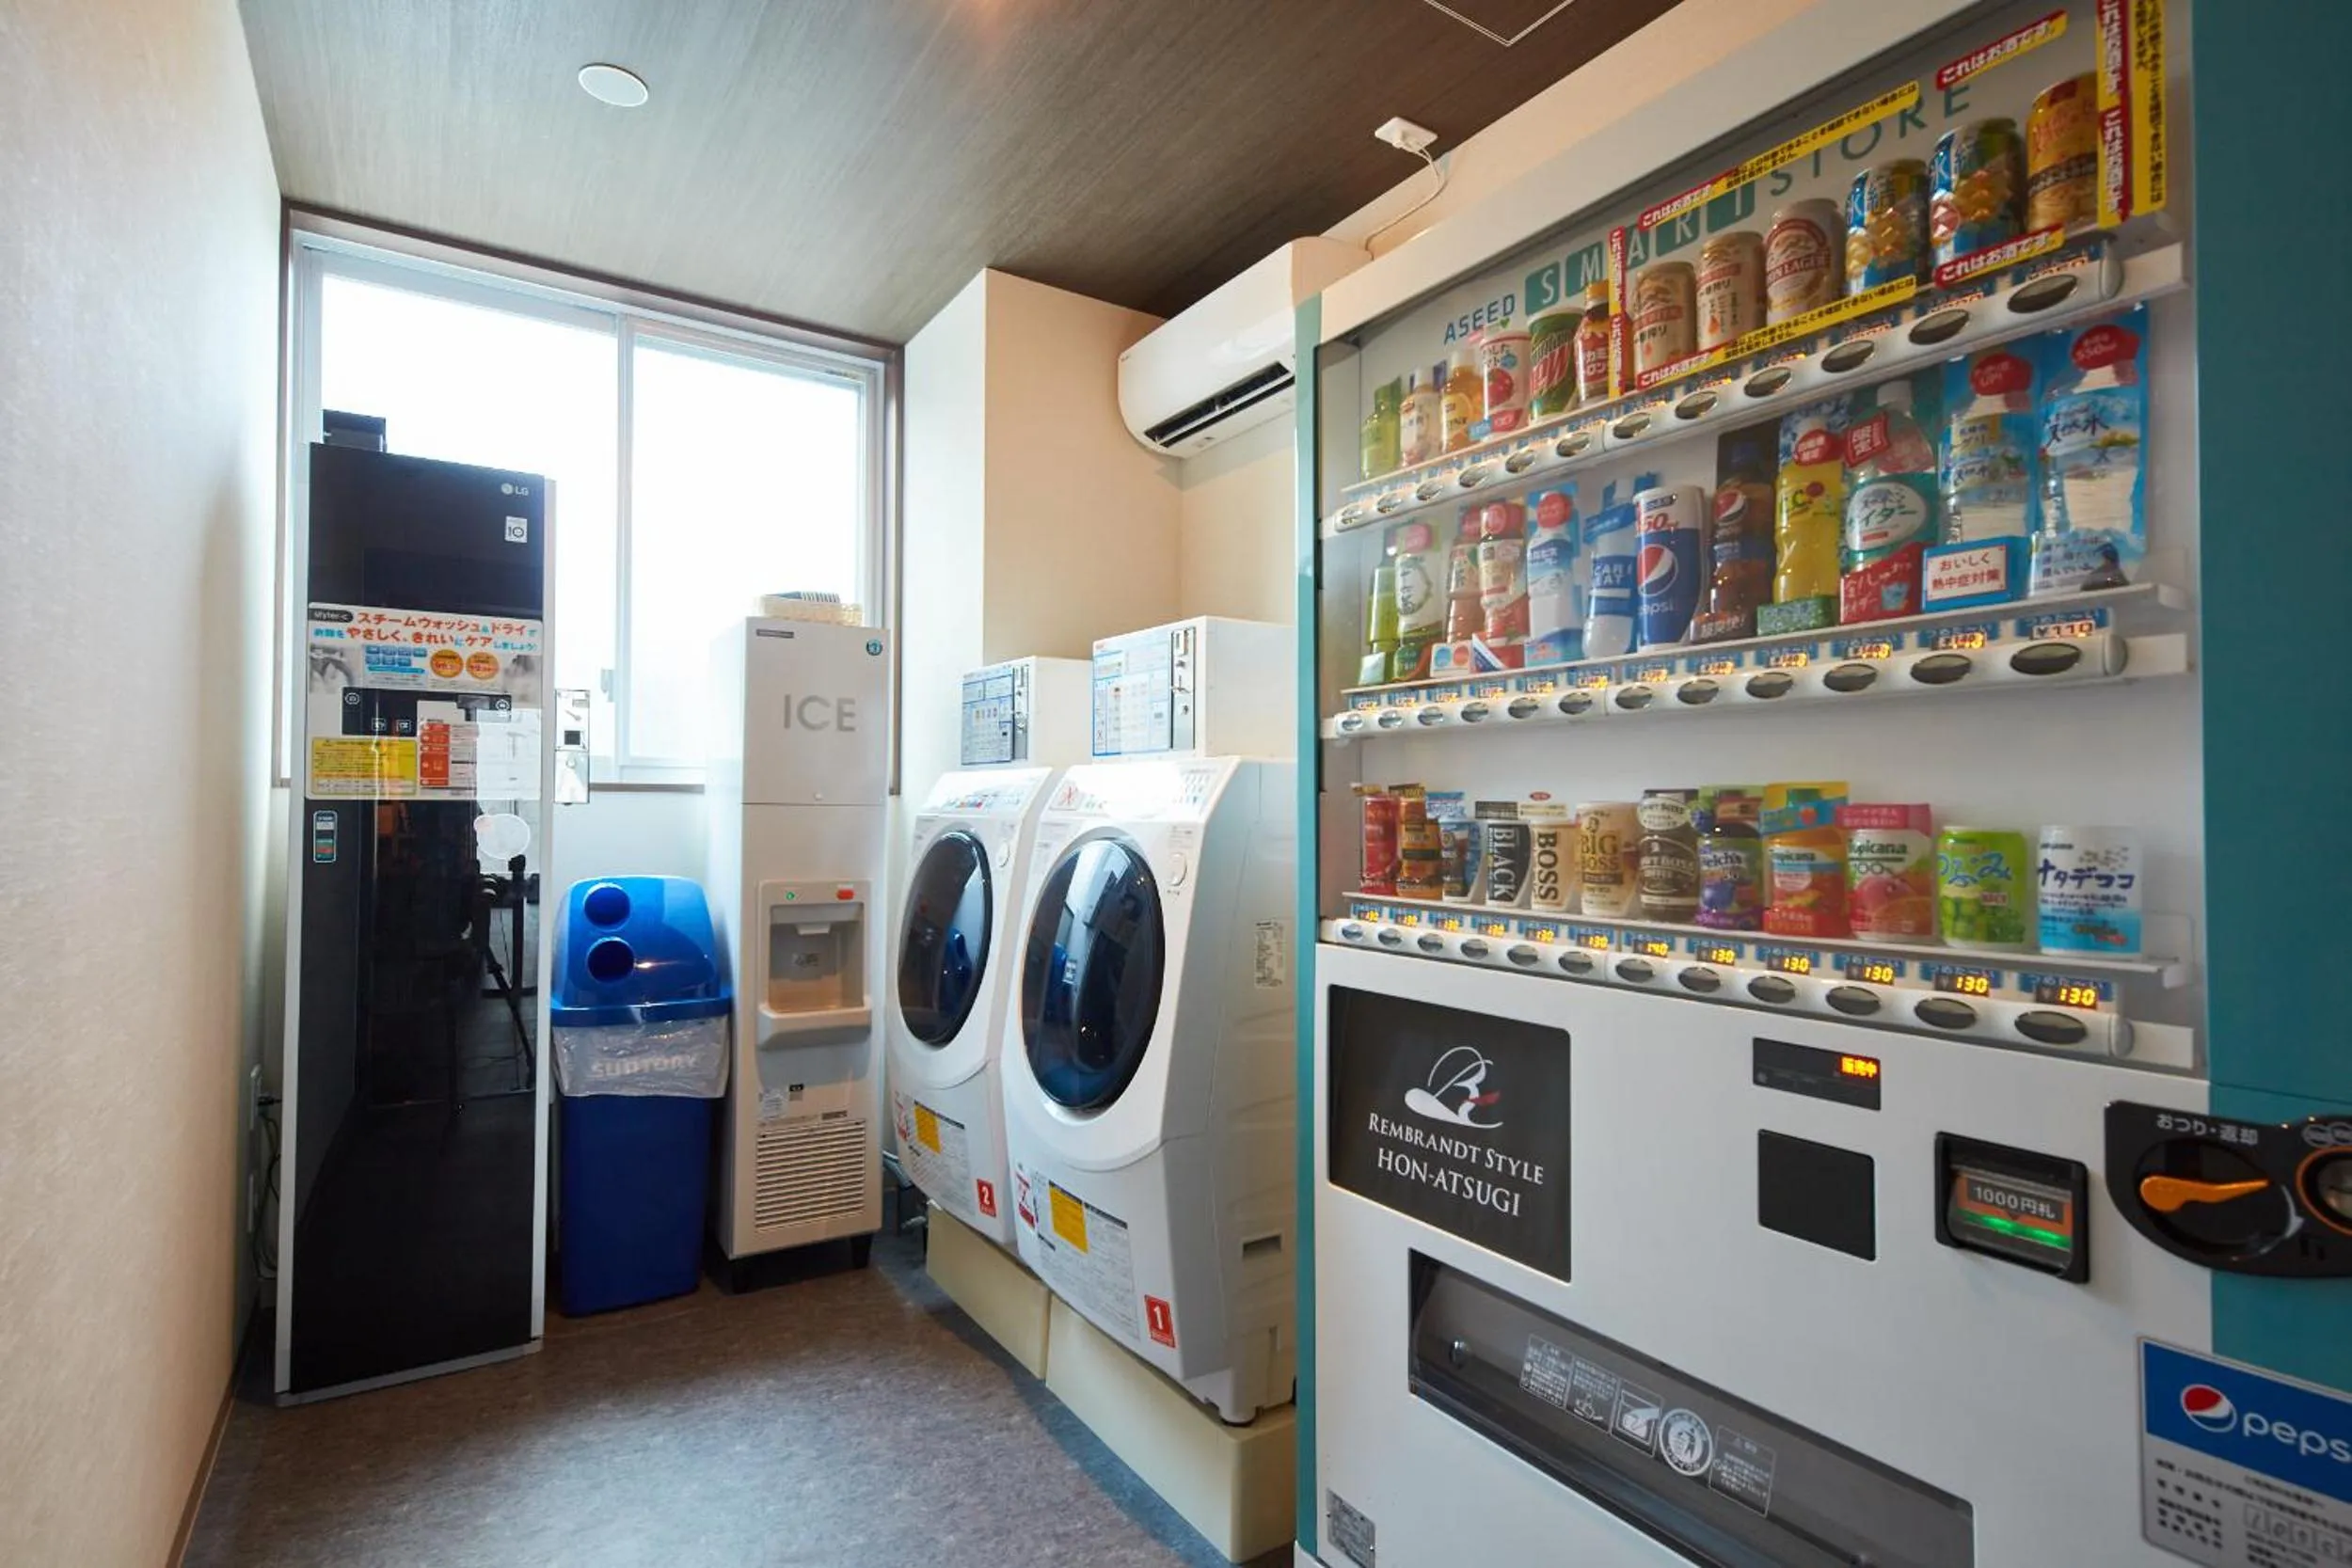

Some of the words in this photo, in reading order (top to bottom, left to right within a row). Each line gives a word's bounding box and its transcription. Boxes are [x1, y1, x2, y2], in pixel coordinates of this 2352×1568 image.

[1942, 21, 2049, 84] これはお酒です
[1941, 232, 2050, 281] これはお酒です
[1443, 293, 1516, 346] ASEED
[515, 485, 529, 497] LG
[1939, 551, 1991, 572] おいしく
[1931, 568, 2001, 591] 熱中症対策
[783, 694, 857, 733] ICE
[1493, 827, 1516, 898] BLACK
[1537, 832, 1558, 900] BOSS
[2037, 857, 2136, 890] ナタデココ
[1711, 948, 1735, 964] 130
[1783, 957, 1810, 973] 130
[1863, 965, 1894, 983] 130
[1956, 975, 1989, 994] 130
[2058, 988, 2096, 1006] 130
[1368, 1112, 1482, 1164] REMBRANDT
[1484, 1148, 1545, 1186] STYLE
[982, 1184, 991, 1206] 2
[1376, 1147, 1522, 1217] HON-ATSUGI
[1973, 1186, 2057, 1220] 1000円札
[1152, 1304, 1165, 1331] 1
